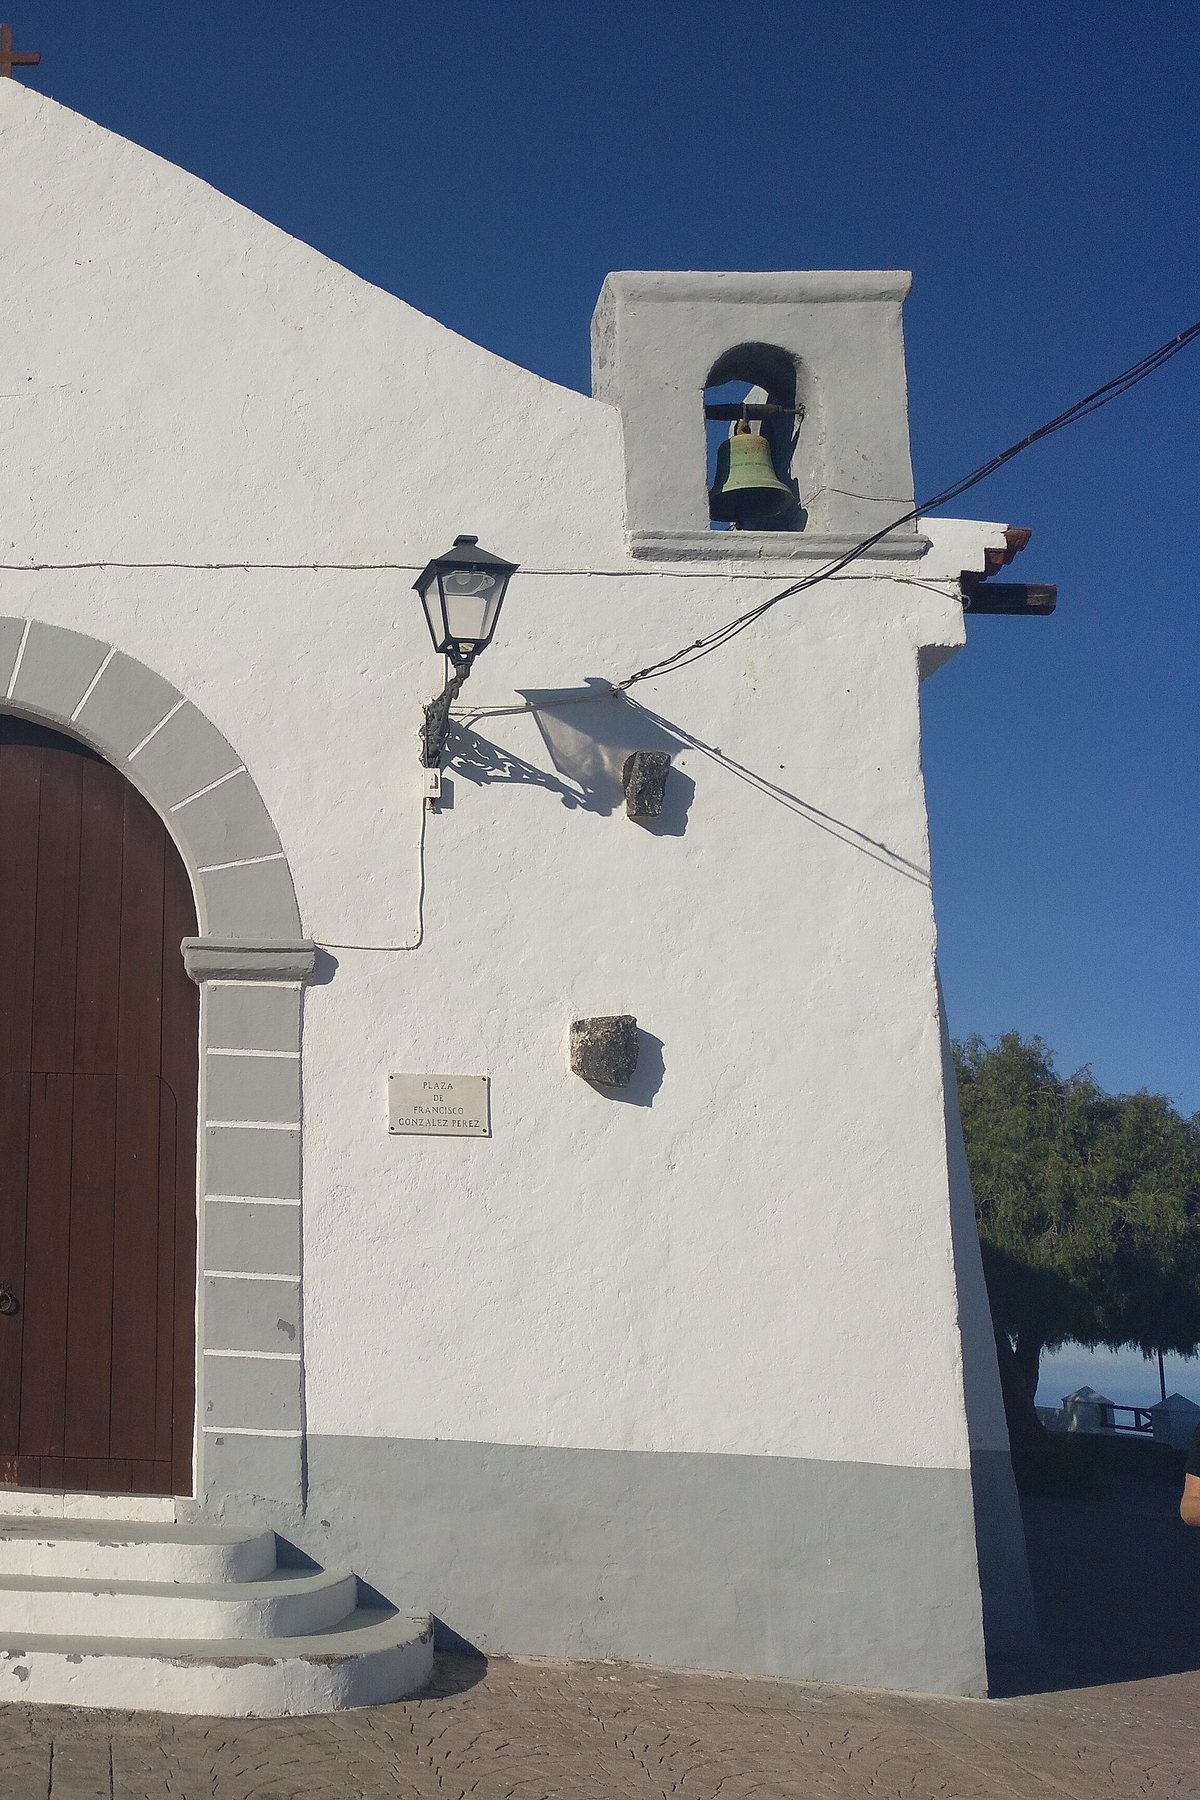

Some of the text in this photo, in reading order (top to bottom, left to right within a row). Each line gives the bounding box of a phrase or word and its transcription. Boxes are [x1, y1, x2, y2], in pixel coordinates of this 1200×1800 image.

[423, 1081, 454, 1090] PLAZA
[433, 1094, 444, 1102] DE
[413, 1106, 464, 1115] FRANCISCO
[398, 1118, 480, 1128] GONZALEZ PEREZ
